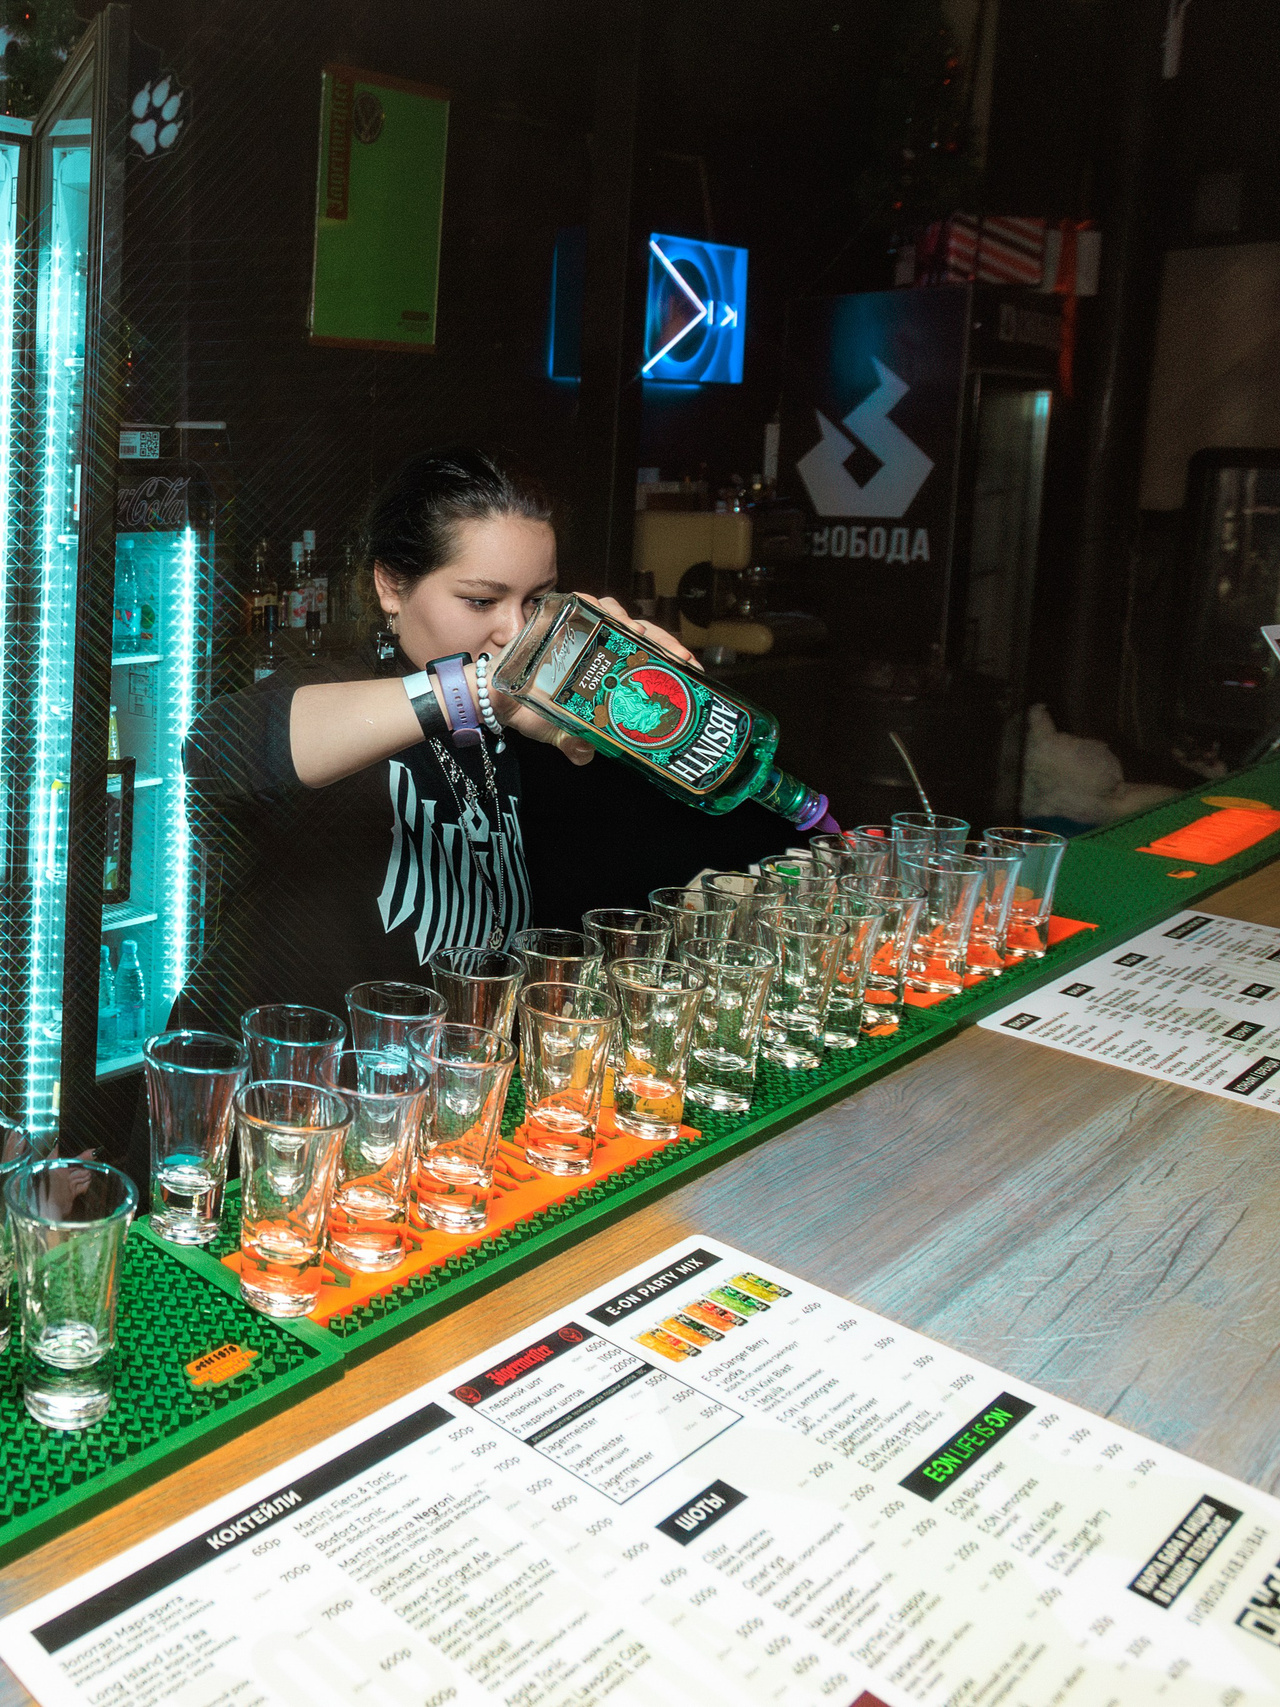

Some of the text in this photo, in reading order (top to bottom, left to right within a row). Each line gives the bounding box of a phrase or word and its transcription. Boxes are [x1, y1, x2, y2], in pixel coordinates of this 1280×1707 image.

[806, 525, 931, 564] ВОБОДА
[578, 651, 606, 690] SCHULZ
[587, 659, 612, 691] FRUKO
[668, 696, 739, 782] ABSINTH
[603, 1257, 704, 1316] E-ON PARTY MIX
[801, 1302, 821, 1314] 450р
[836, 1318, 857, 1331] 550р
[584, 1339, 606, 1352] 450р
[596, 1348, 621, 1362] 1100р
[700, 1337, 769, 1382] E-ON Danger Berry
[873, 1336, 894, 1349] 550р
[609, 1356, 636, 1373] 2200р
[644, 1373, 667, 1387] 550р
[722, 1368, 745, 1384] vodka
[737, 1363, 793, 1402] E-ON Kiwi Blast
[488, 1387, 525, 1411] ледяной
[525, 1377, 542, 1389] шот
[504, 1395, 542, 1420] ледяных
[541, 1382, 564, 1397] шота
[520, 1404, 557, 1430] ледяных
[557, 1388, 585, 1406] шотов
[671, 1388, 694, 1402] 550р
[699, 1403, 722, 1418] 550р
[756, 1386, 785, 1404] tequila
[775, 1378, 839, 1422] E-ON Lemongrass
[447, 1426, 474, 1441] 500р
[542, 1417, 596, 1453] Jagermeister
[796, 1415, 810, 1427] gin
[815, 1397, 877, 1445] E-ON Black Power
[971, 1422, 995, 1438] IS
[980, 1406, 1014, 1430] ON
[470, 1440, 497, 1457] 500р
[569, 1434, 623, 1471] Jagermeister
[604, 1446, 629, 1464] вишня
[856, 1409, 930, 1467] E-ON vodka party mix
[948, 1431, 985, 1459] LIFE
[598, 1451, 652, 1490] Jagermeister
[617, 1477, 640, 1493] E-ON
[944, 1461, 1005, 1515] E-ON Black Power
[203, 1487, 302, 1549] КОКТЕЙЛИ
[292, 1508, 331, 1531] Martini
[330, 1492, 358, 1509] Fiero
[364, 1471, 394, 1488] Tonic
[673, 1491, 727, 1531] ШОТЫ
[314, 1506, 386, 1551] Bosford Tonic
[337, 1494, 454, 1568] Martini Riserva Negroni
[251, 1538, 281, 1556] 650р
[279, 1563, 311, 1582] 700р
[369, 1547, 444, 1594] Oakheart Cola
[436, 1562, 472, 1587] Ginger
[471, 1551, 490, 1565] Ale
[464, 1572, 531, 1618] Blackcurrant
[527, 1558, 550, 1574] Fizz
[114, 1596, 183, 1637] Маргарита
[87, 1629, 207, 1704] Long Island Ice Tea
